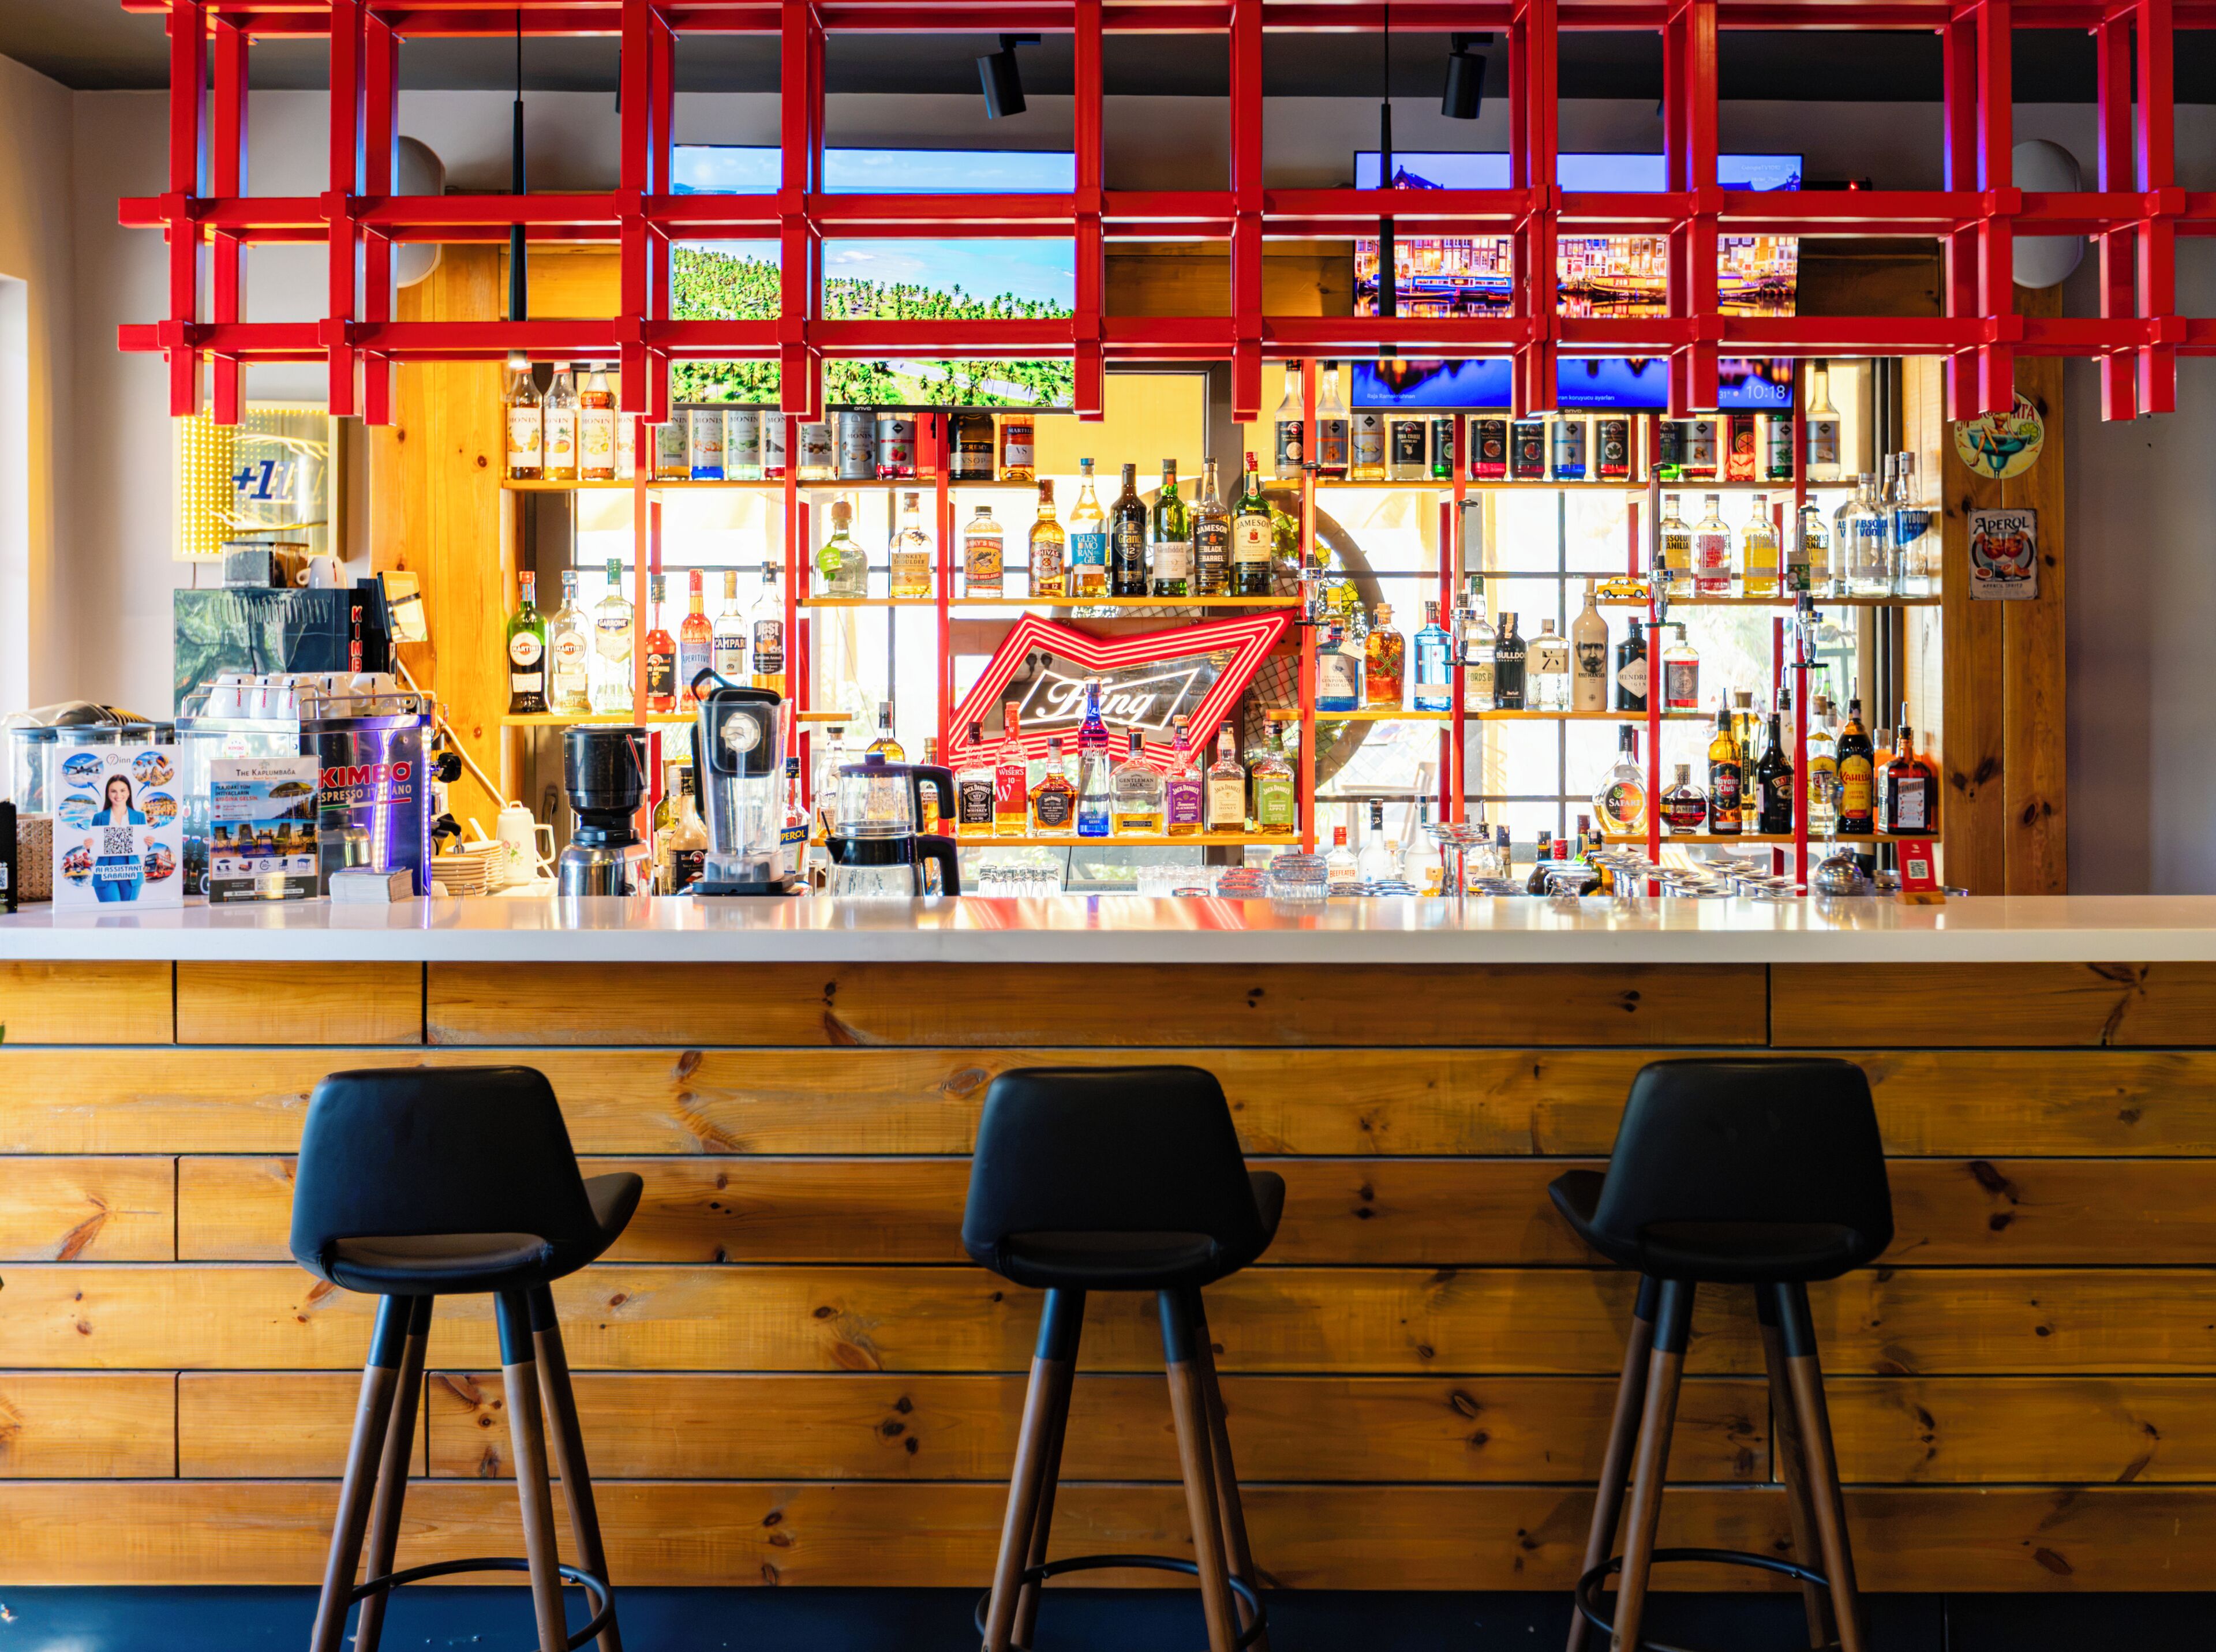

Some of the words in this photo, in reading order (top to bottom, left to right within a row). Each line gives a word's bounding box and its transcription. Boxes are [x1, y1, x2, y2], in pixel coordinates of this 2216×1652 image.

[1746, 385, 1785, 399] 10:18
[1016, 447, 1027, 455] VS
[1237, 519, 1270, 530] JAMESON
[1855, 519, 1888, 529] ABSOLU
[1973, 516, 2030, 535] APEROL
[1196, 525, 1228, 534] JAMESON
[1078, 549, 1094, 557] RAN
[1084, 556, 1096, 564] GIE
[598, 619, 628, 628] GARRONE
[351, 605, 363, 673] KIMB
[682, 655, 709, 664] APERITIVO
[1467, 673, 1486, 681] FORDS
[319, 761, 411, 789] KIMBO
[1714, 776, 1739, 785] Havana
[963, 785, 974, 795] JACK
[997, 784, 1012, 801] W
[1173, 786, 1183, 795] JACK
[1183, 784, 1200, 795] DANIEL'S
[1214, 785, 1224, 793] JACK
[1263, 786, 1273, 795] JACK
[1719, 784, 1734, 792] Club
[1608, 798, 1642, 807] SAFARI
[1724, 799, 1730, 808] 7
[781, 829, 806, 842] PEROL
